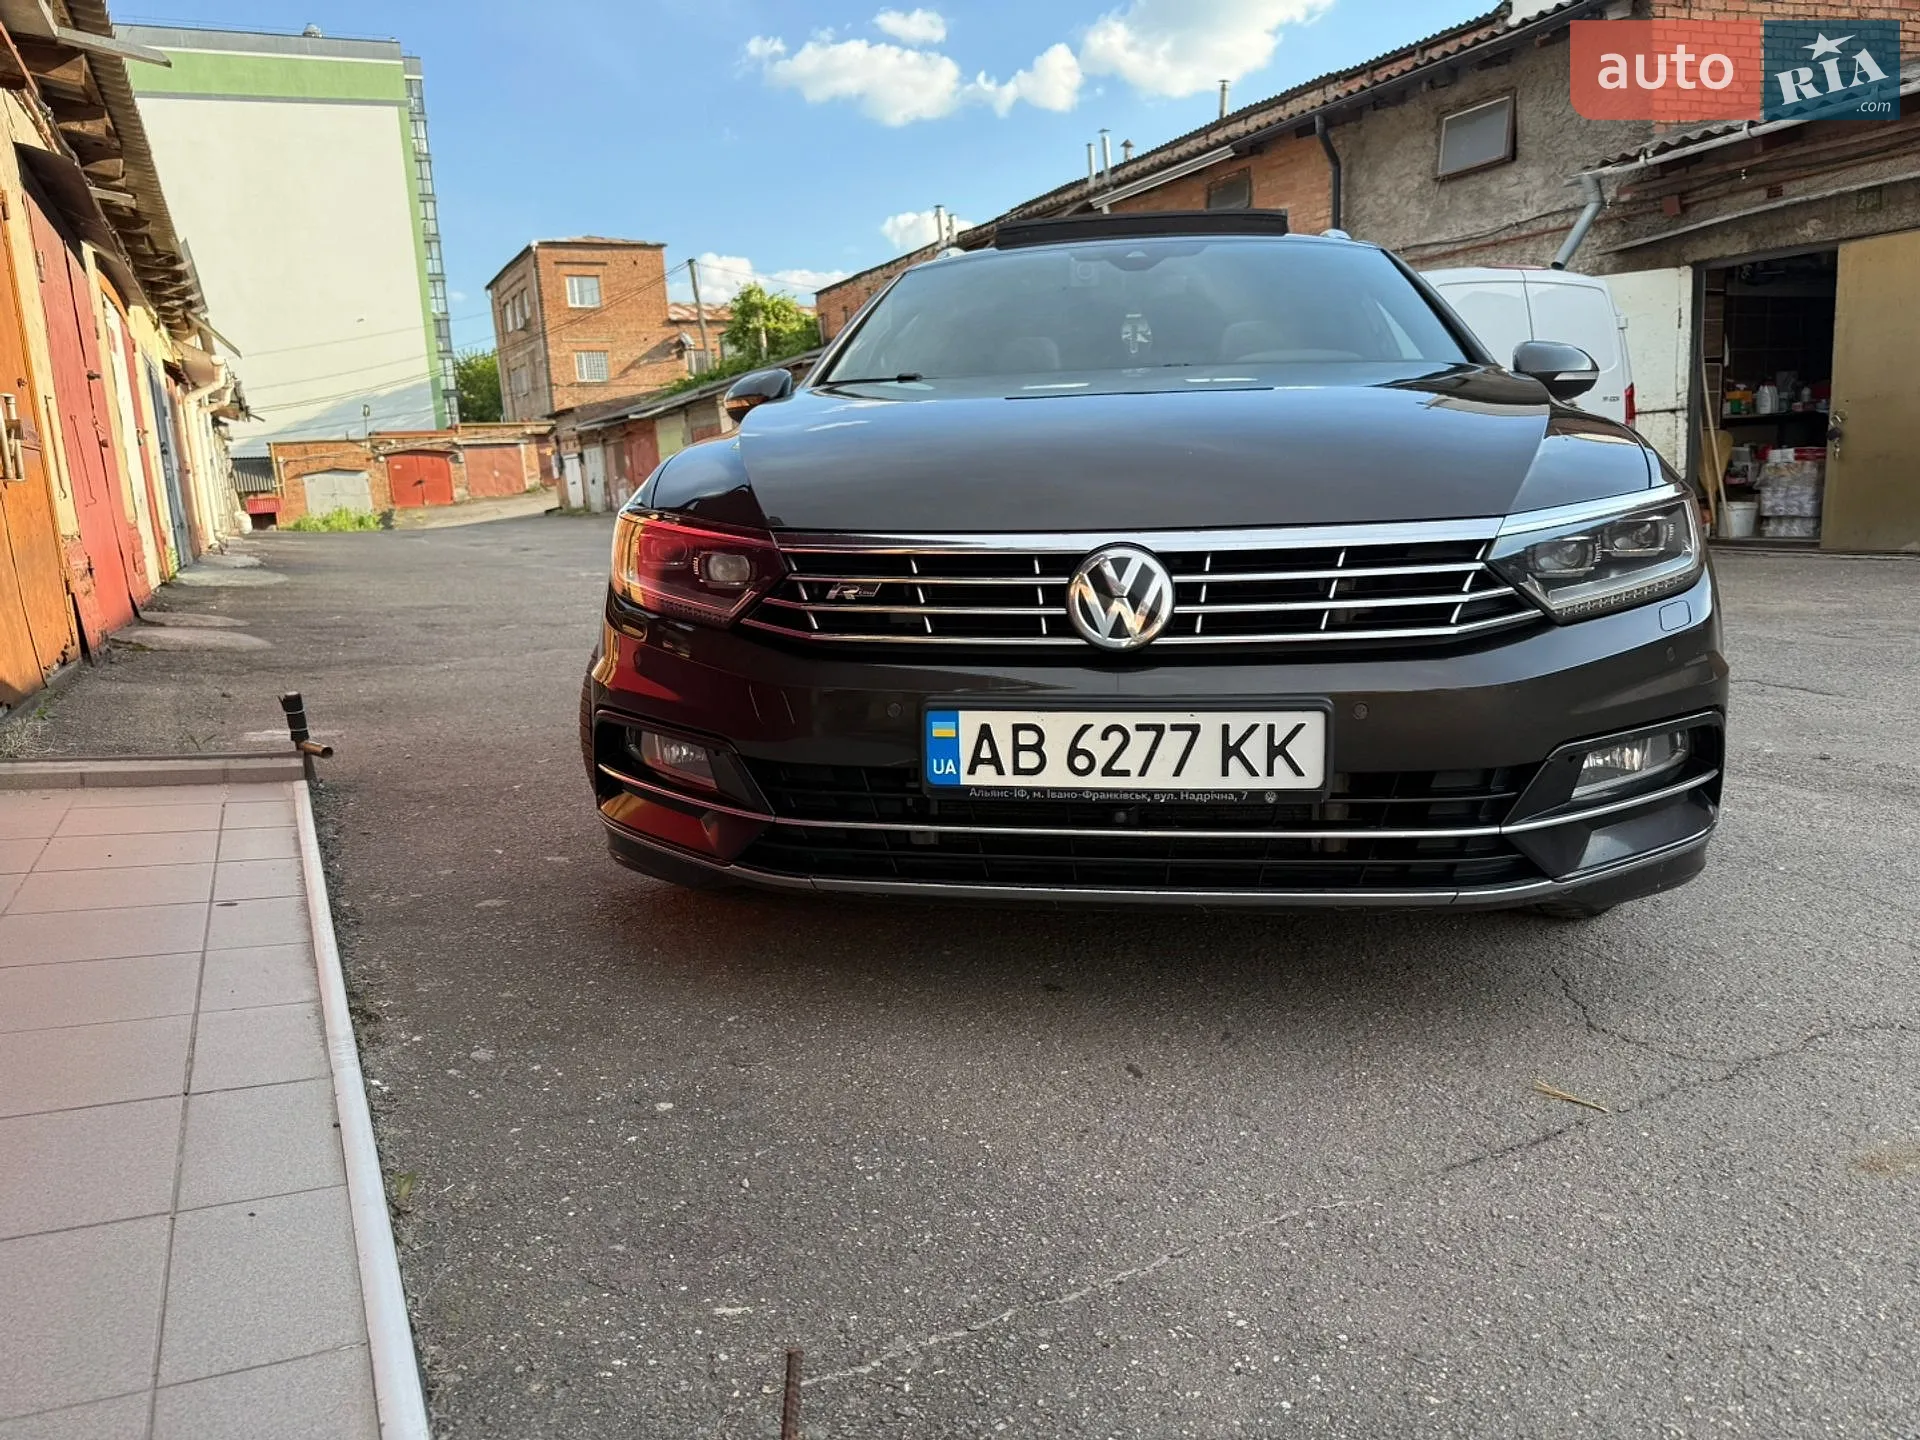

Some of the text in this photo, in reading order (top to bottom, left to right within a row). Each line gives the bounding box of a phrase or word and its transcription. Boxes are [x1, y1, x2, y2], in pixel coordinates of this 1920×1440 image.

[933, 758, 957, 775] UA
[966, 723, 1306, 777] AB 6277 KK
